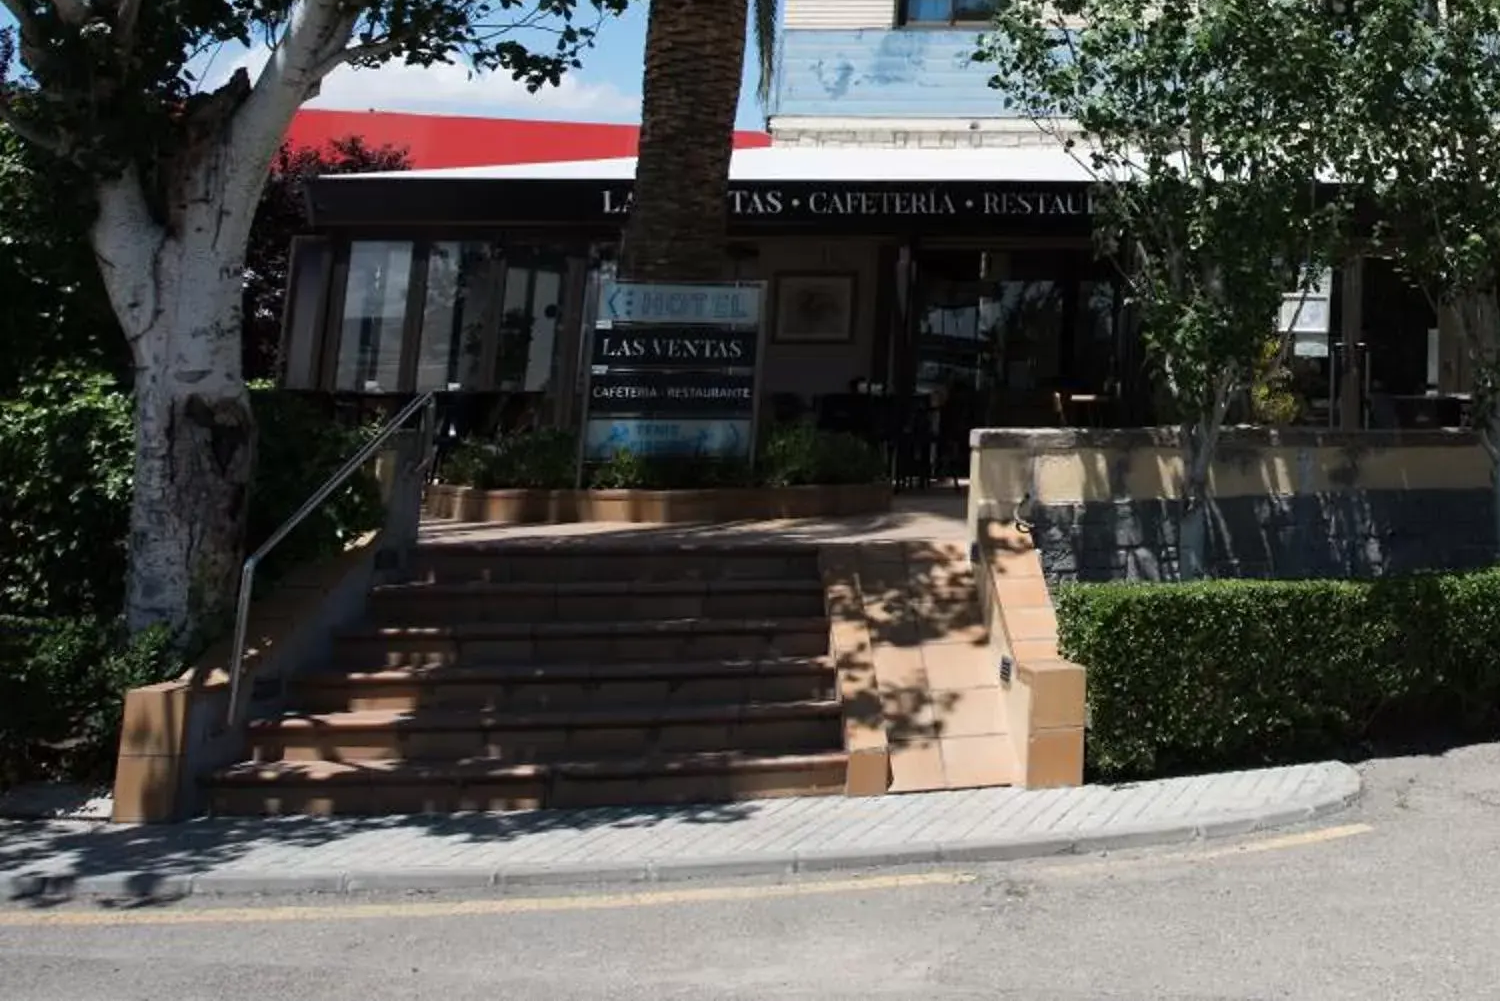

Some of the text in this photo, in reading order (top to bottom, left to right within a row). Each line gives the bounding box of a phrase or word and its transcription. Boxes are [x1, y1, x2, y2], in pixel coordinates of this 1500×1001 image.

[640, 292, 748, 319] HOTEL
[602, 338, 743, 359] LAS VENTAS
